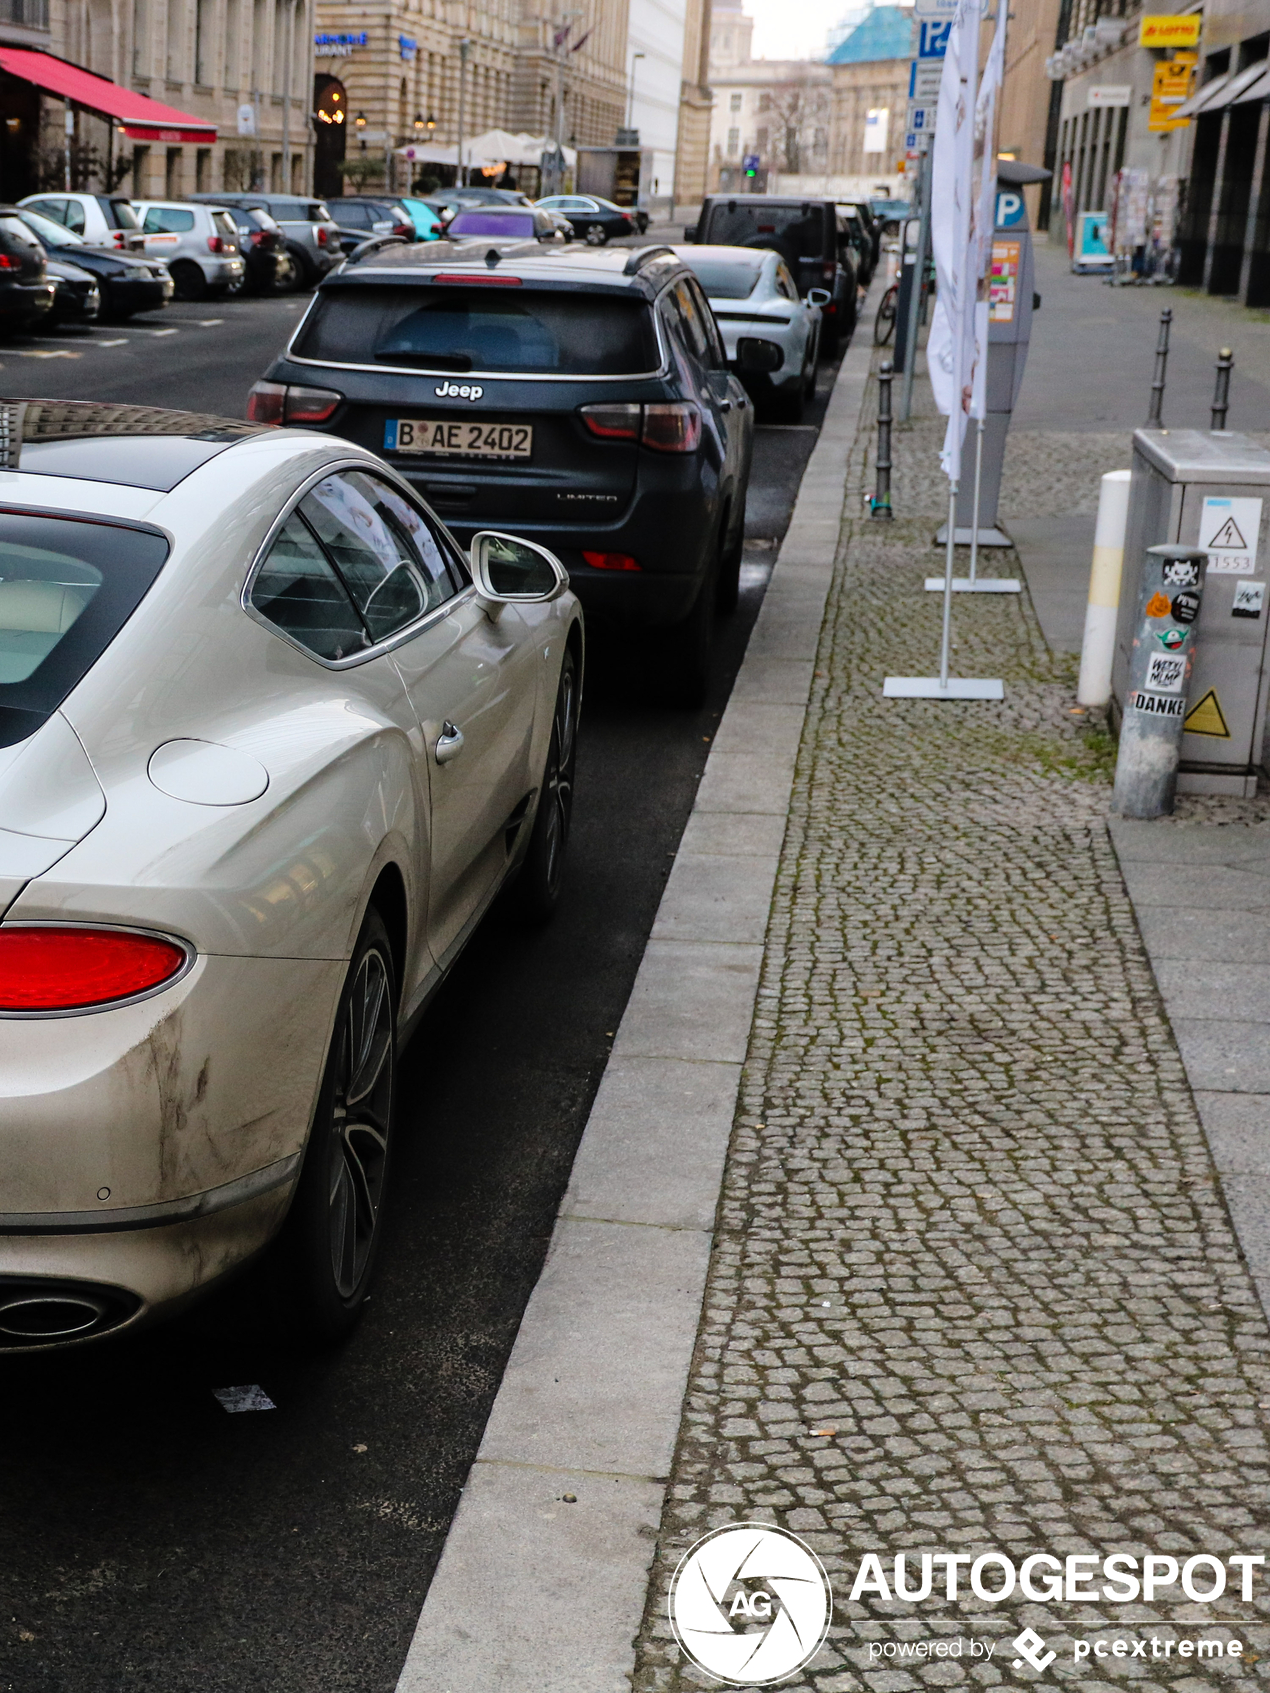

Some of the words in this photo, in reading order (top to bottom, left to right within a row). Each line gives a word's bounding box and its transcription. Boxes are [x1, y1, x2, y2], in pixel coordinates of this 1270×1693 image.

[996, 193, 1021, 226] P
[435, 381, 483, 401] Jeep
[399, 423, 414, 446] B
[431, 424, 461, 449] AE
[467, 426, 529, 452] 2402
[557, 493, 618, 502] LIMITED
[1135, 693, 1184, 715] DANKE
